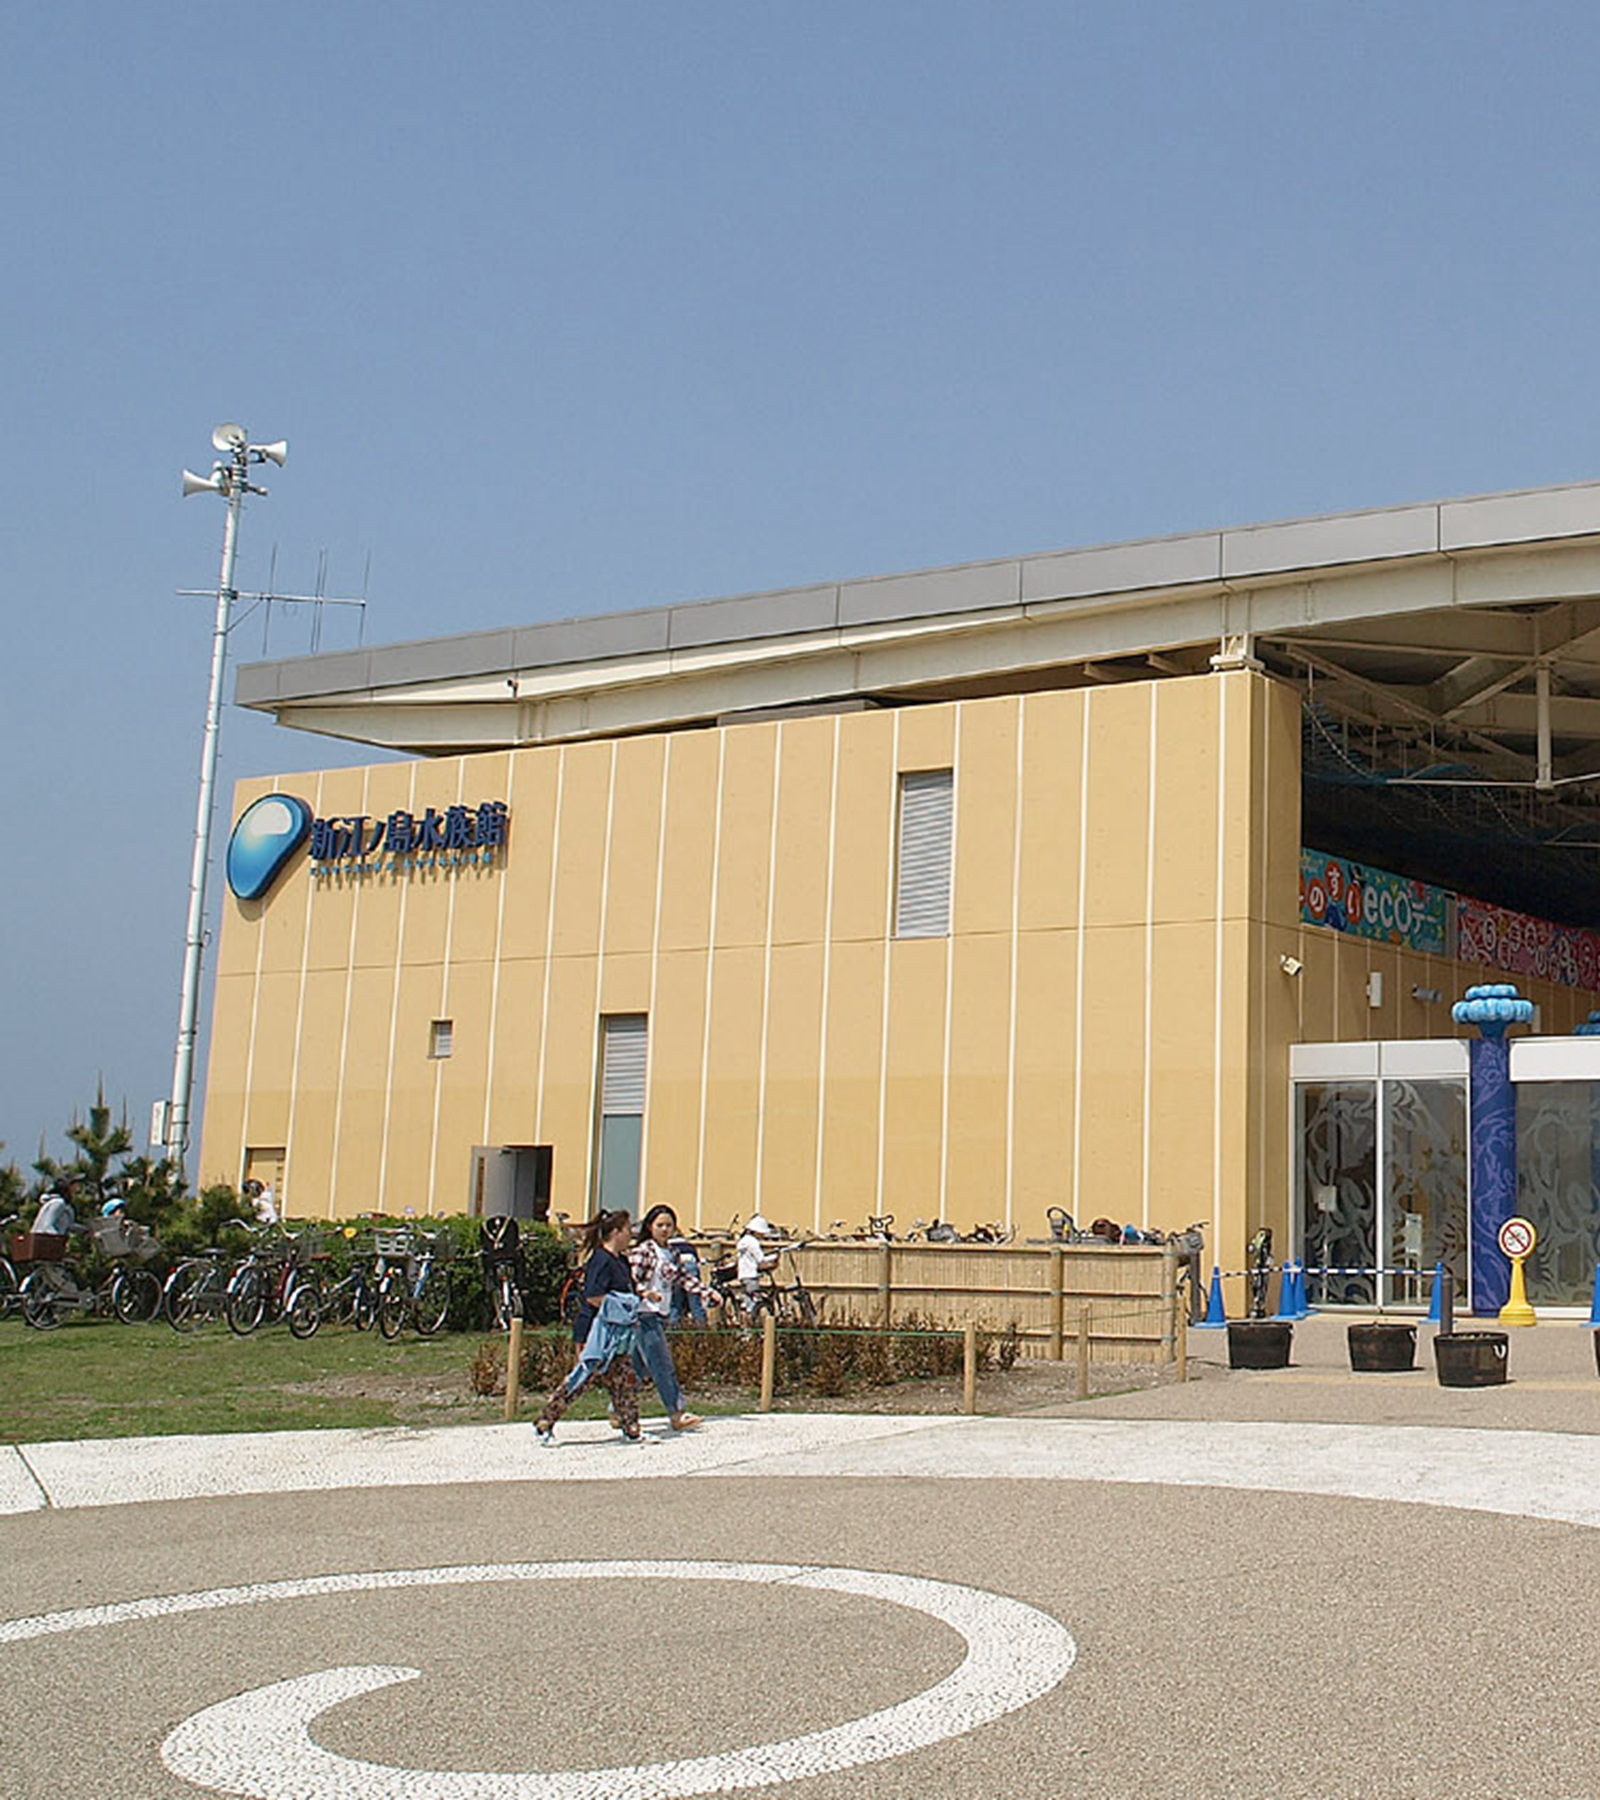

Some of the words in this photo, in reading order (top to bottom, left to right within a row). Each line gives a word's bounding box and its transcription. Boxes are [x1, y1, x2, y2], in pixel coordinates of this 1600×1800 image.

[309, 801, 508, 859] 新江ノ島水族館
